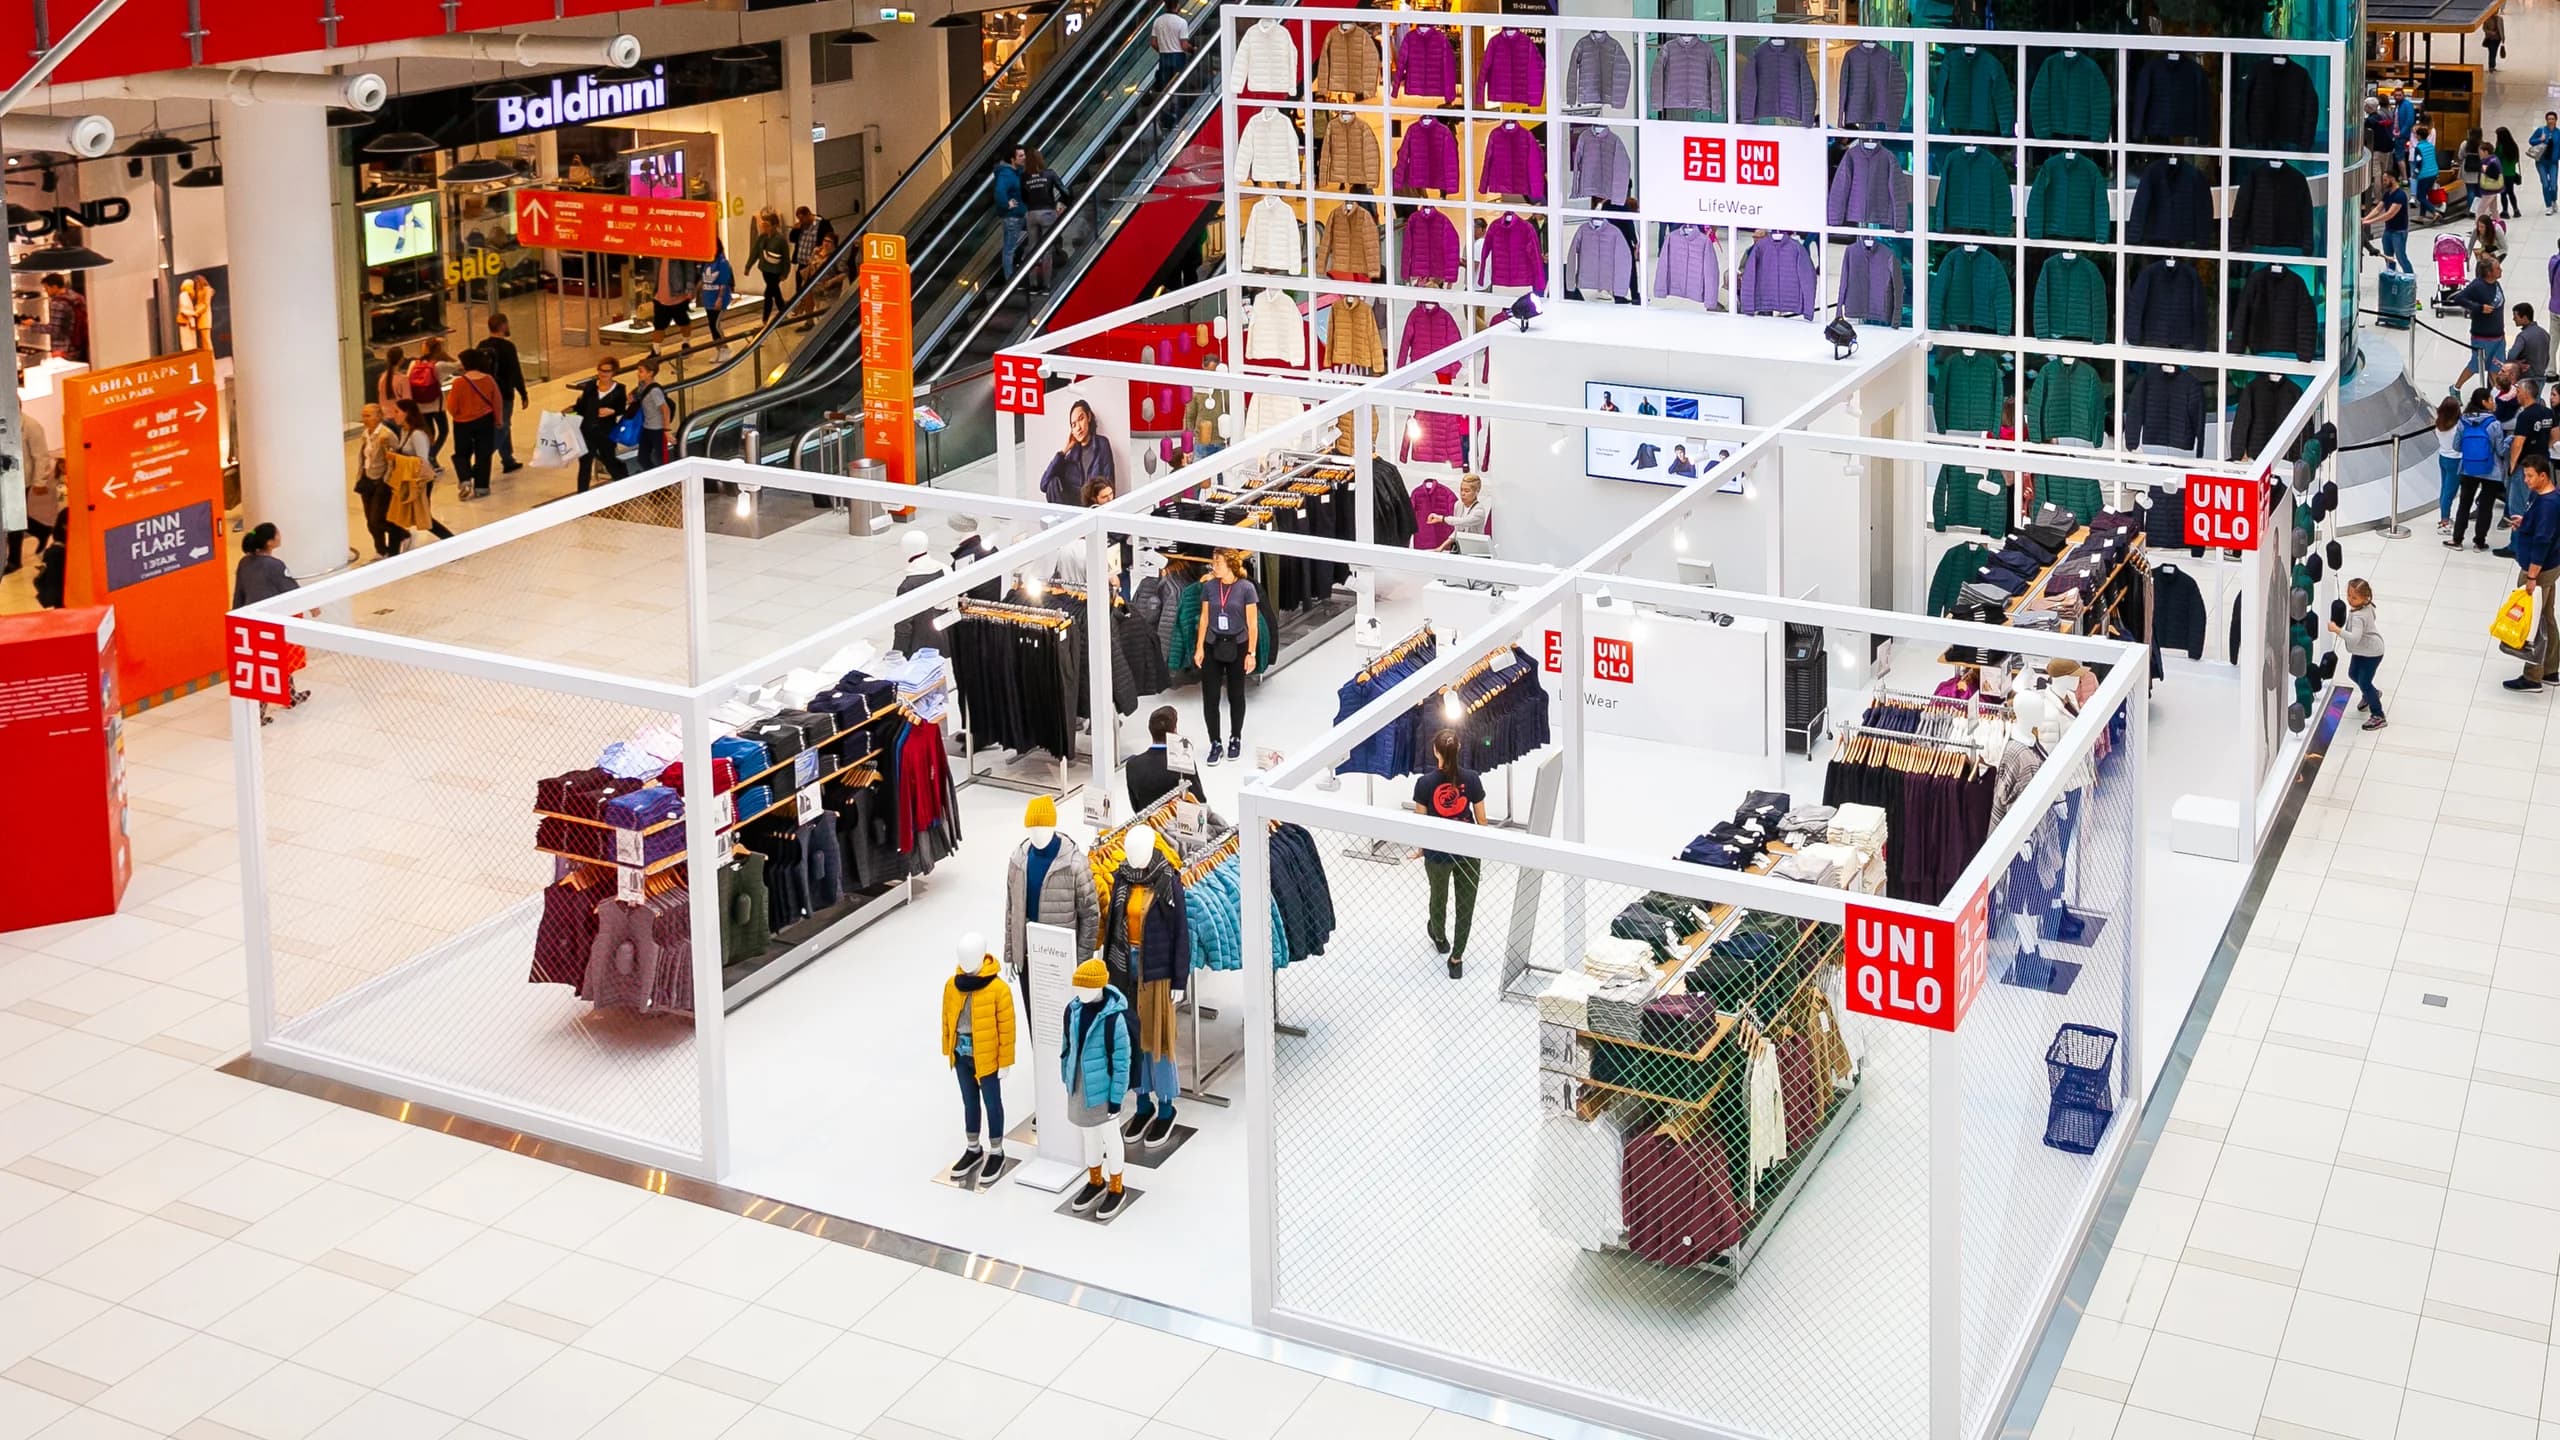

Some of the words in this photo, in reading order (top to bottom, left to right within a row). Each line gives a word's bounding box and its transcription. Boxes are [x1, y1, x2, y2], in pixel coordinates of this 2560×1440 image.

[498, 64, 665, 133] Baldinini
[1697, 198, 1763, 216] LifeWear
[869, 239, 880, 259] 1
[884, 244, 894, 257] D
[447, 247, 501, 286] sale
[864, 315, 871, 326] 3
[864, 346, 871, 357] 2
[88, 376, 133, 397] АВИА
[136, 364, 180, 385] ПАРК
[188, 362, 203, 386] 1
[135, 512, 181, 539] FINN
[131, 529, 187, 560] FLARE
[1032, 943, 1068, 959] LifeWear
